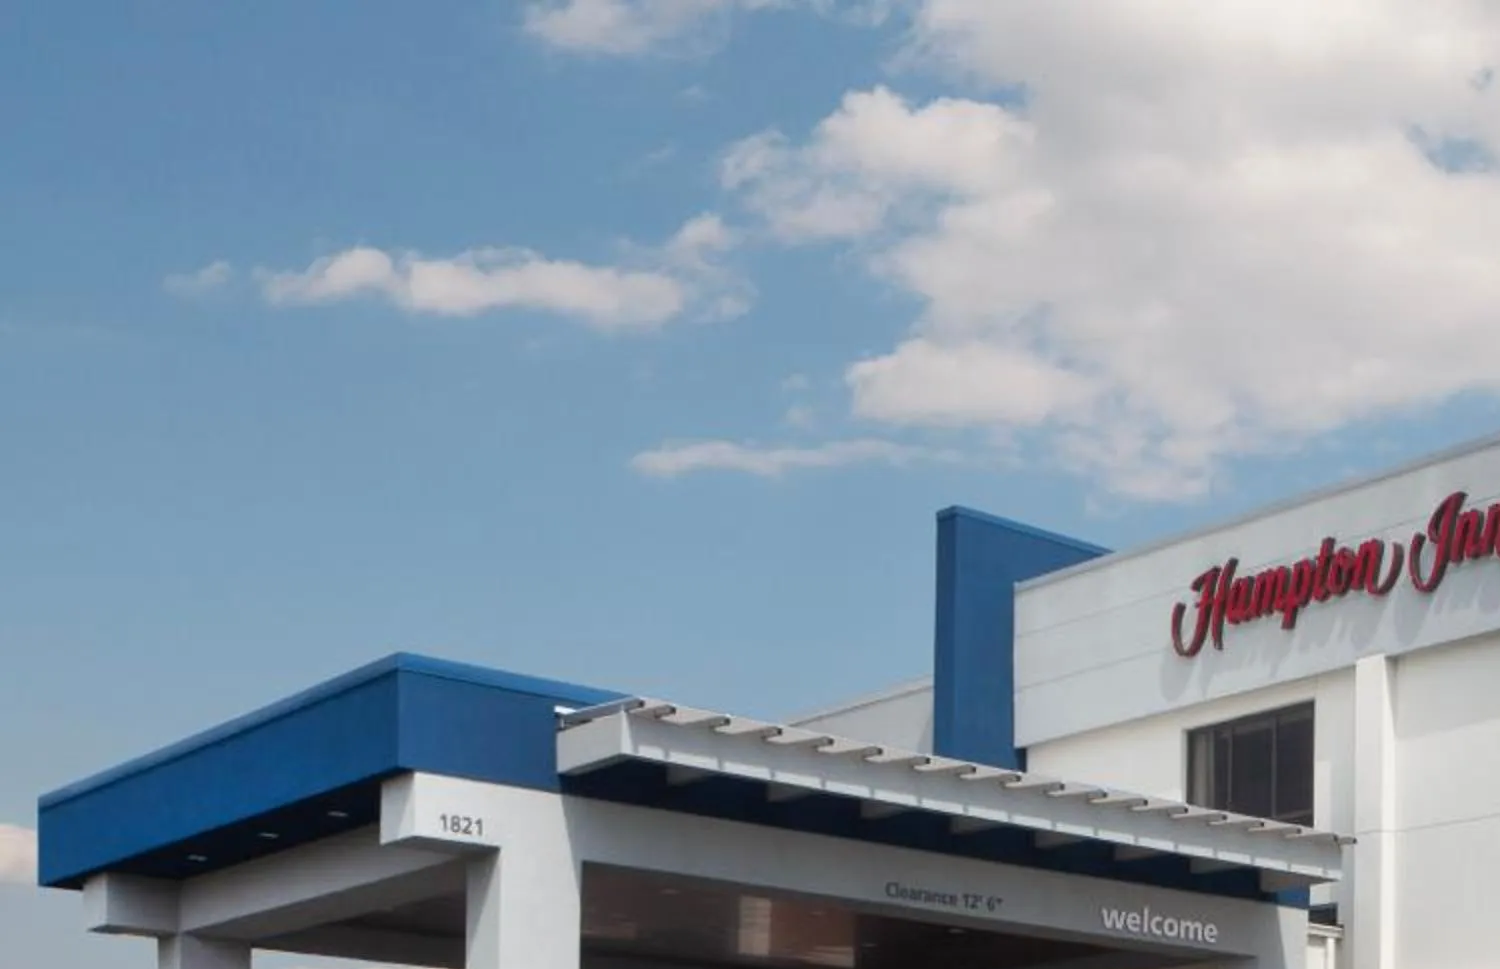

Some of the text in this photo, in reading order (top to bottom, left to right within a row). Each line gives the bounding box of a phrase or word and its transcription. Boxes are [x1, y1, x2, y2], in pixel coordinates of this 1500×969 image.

[1171, 536, 1404, 658] Hampton
[440, 813, 483, 836] 1821
[884, 881, 958, 906] Clearance
[1101, 906, 1218, 943] welcome
